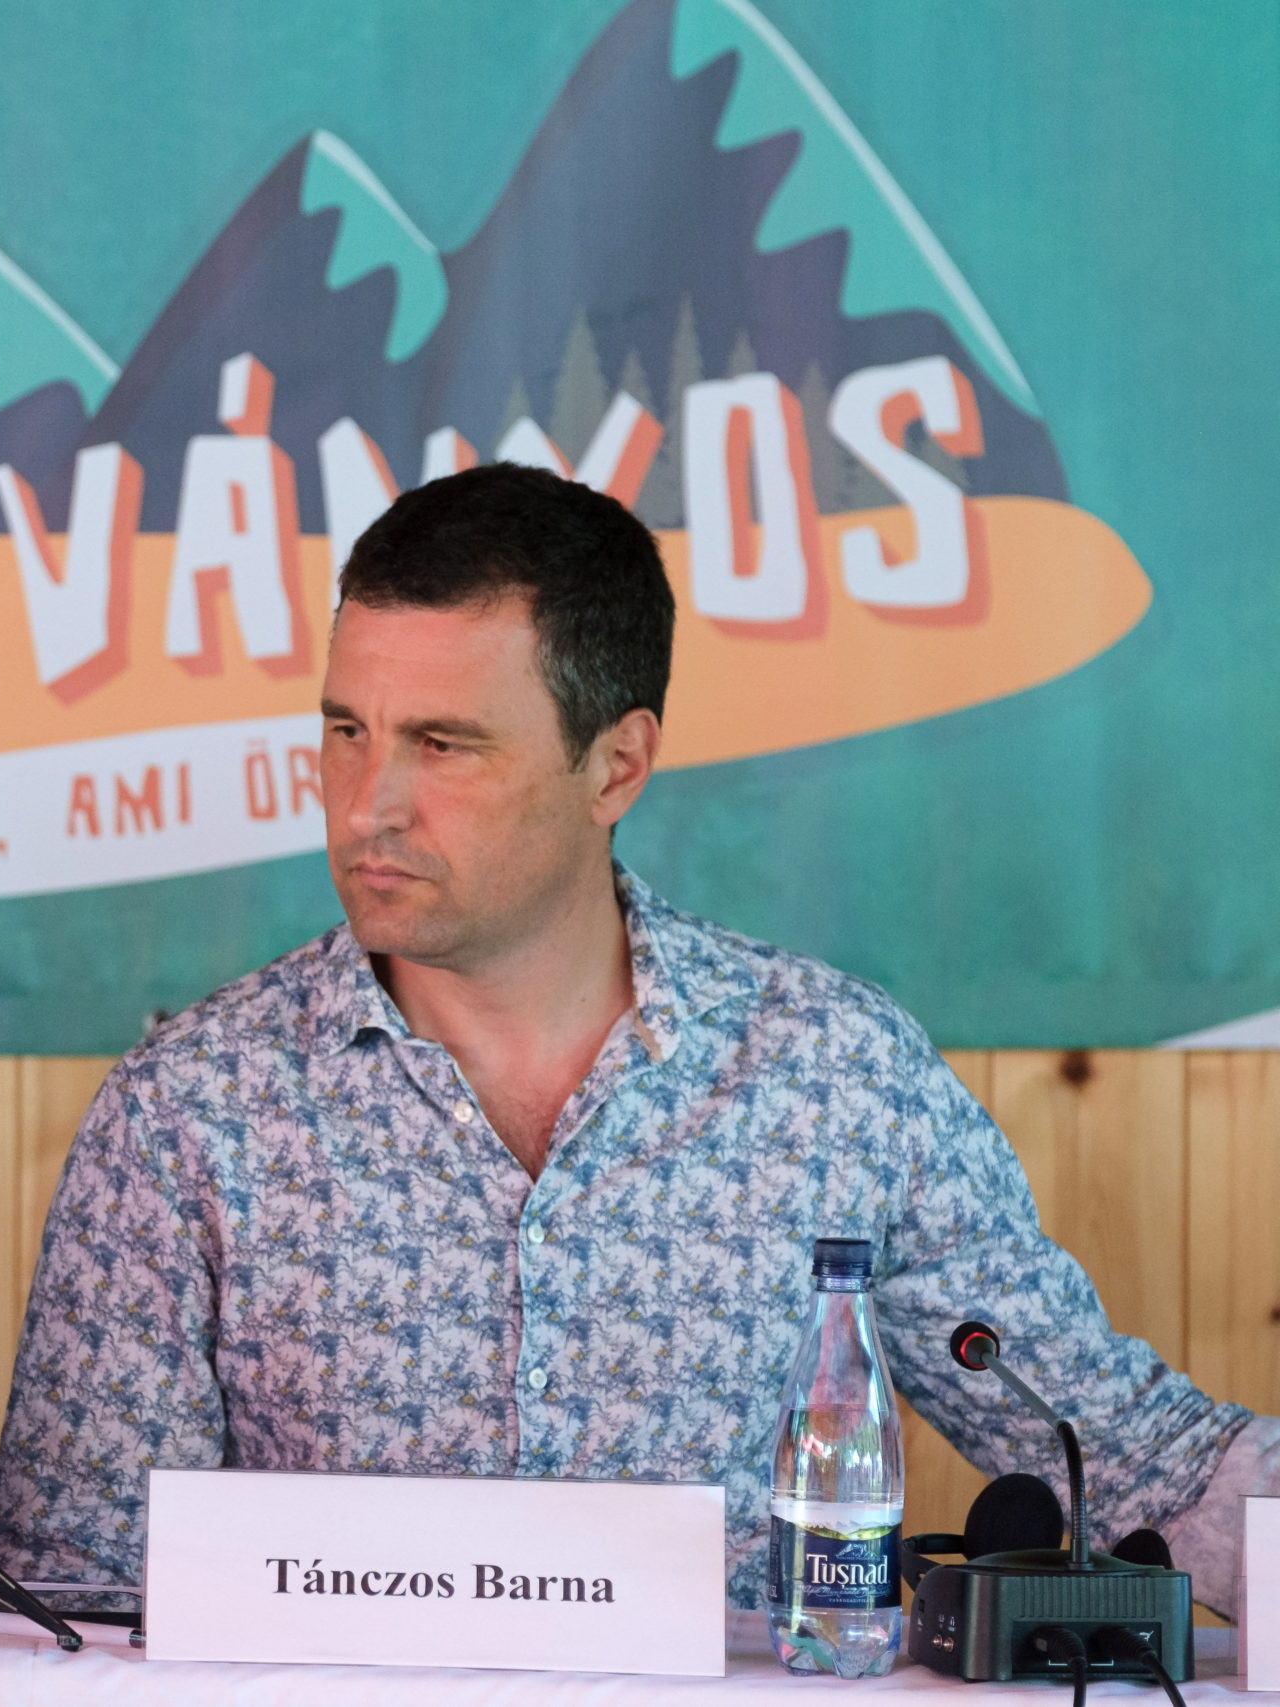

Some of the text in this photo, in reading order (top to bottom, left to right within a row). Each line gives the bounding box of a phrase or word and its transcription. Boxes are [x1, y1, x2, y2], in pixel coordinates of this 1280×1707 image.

[66, 761, 193, 838] AMI
[242, 739, 323, 822] ÖR
[265, 1558, 616, 1604] Tánczos Barna
